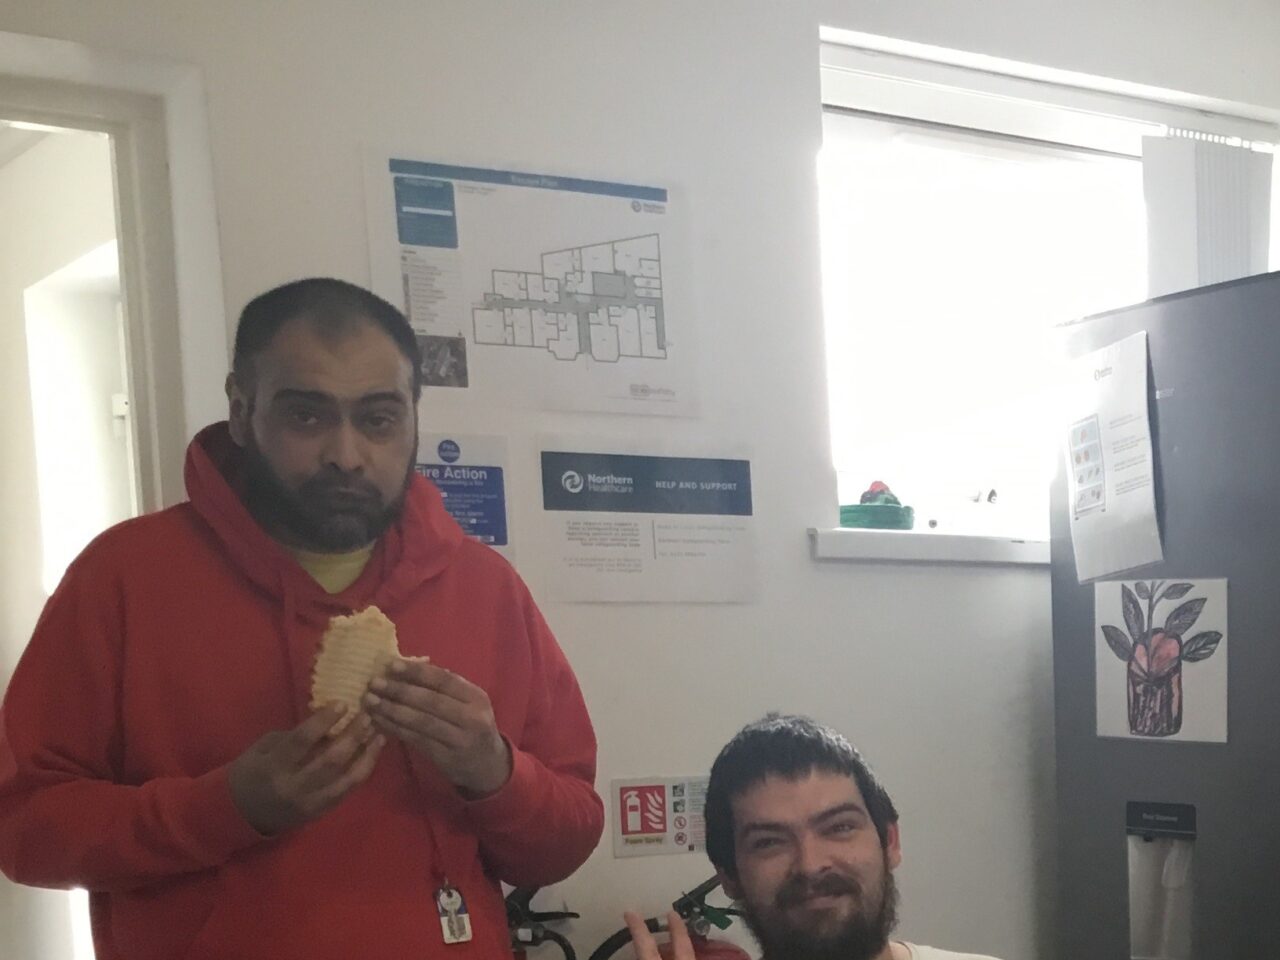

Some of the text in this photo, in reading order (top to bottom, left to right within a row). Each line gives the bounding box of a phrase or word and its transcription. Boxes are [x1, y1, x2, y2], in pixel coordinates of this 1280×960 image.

[444, 466, 487, 480] Action
[588, 473, 633, 485] Northern
[656, 480, 737, 491] HELP AND SUPPORT
